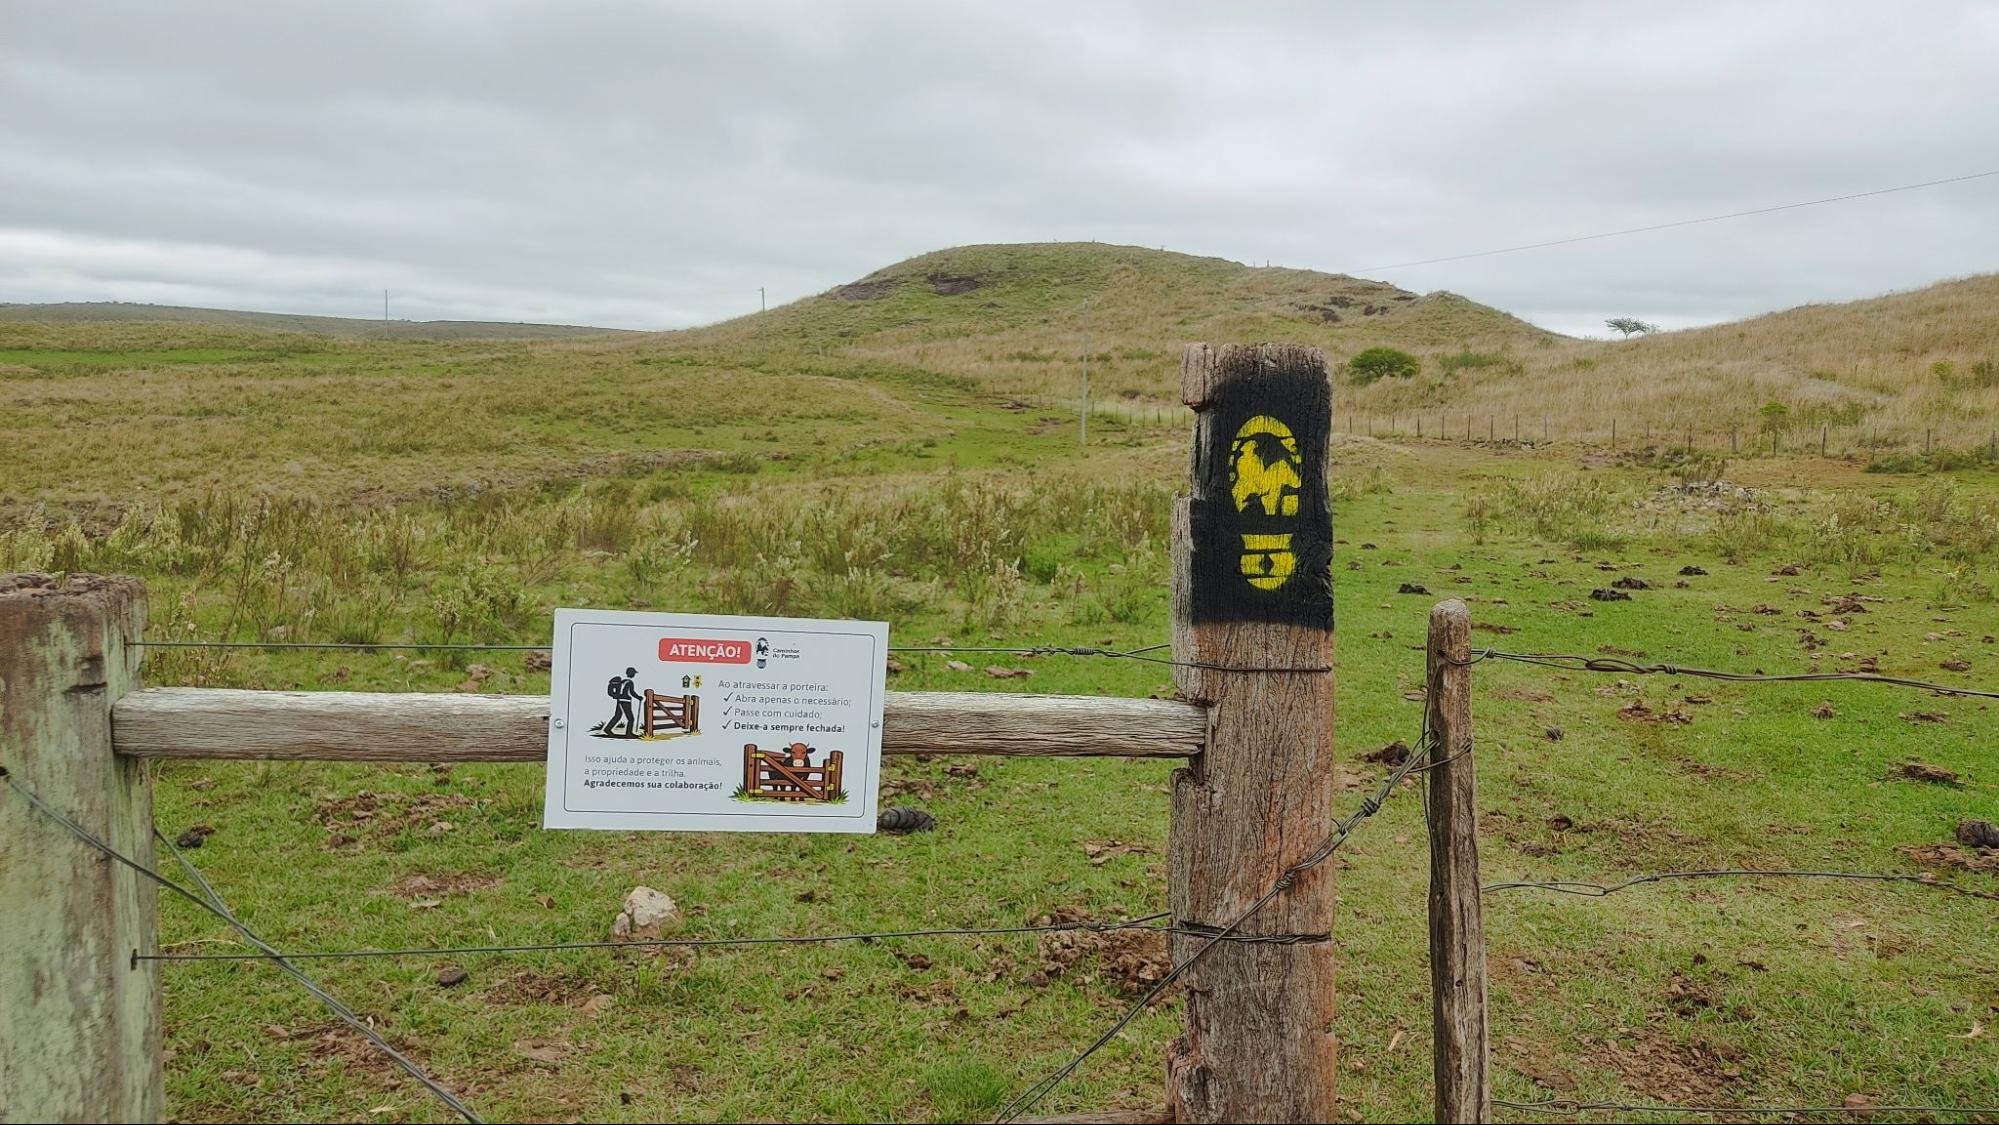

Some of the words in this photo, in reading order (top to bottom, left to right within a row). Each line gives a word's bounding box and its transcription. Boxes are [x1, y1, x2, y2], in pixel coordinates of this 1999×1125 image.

[669, 643, 741, 660] ATENÇÃO!
[718, 680, 730, 688] Ao
[733, 681, 780, 690] atravessar
[790, 682, 829, 693] porteira:
[735, 694, 756, 703] Abra
[758, 696, 792, 706] apenas
[801, 697, 851, 707] necessário;
[734, 708, 760, 717] Passe
[762, 709, 782, 718] com
[784, 709, 822, 720] cuidado;
[734, 722, 768, 731] Deixe-a
[770, 723, 804, 733] sempre
[806, 723, 845, 733] fechada!
[585, 755, 601, 763] Isso
[603, 755, 628, 765] ajuda
[637, 757, 673, 766] proteger
[687, 757, 722, 767] animais,
[591, 767, 645, 777] propriedade
[661, 769, 686, 778] trilha.
[584, 779, 645, 789] Agradecemos
[647, 781, 662, 789] sua
[664, 780, 723, 791] colaboração!
